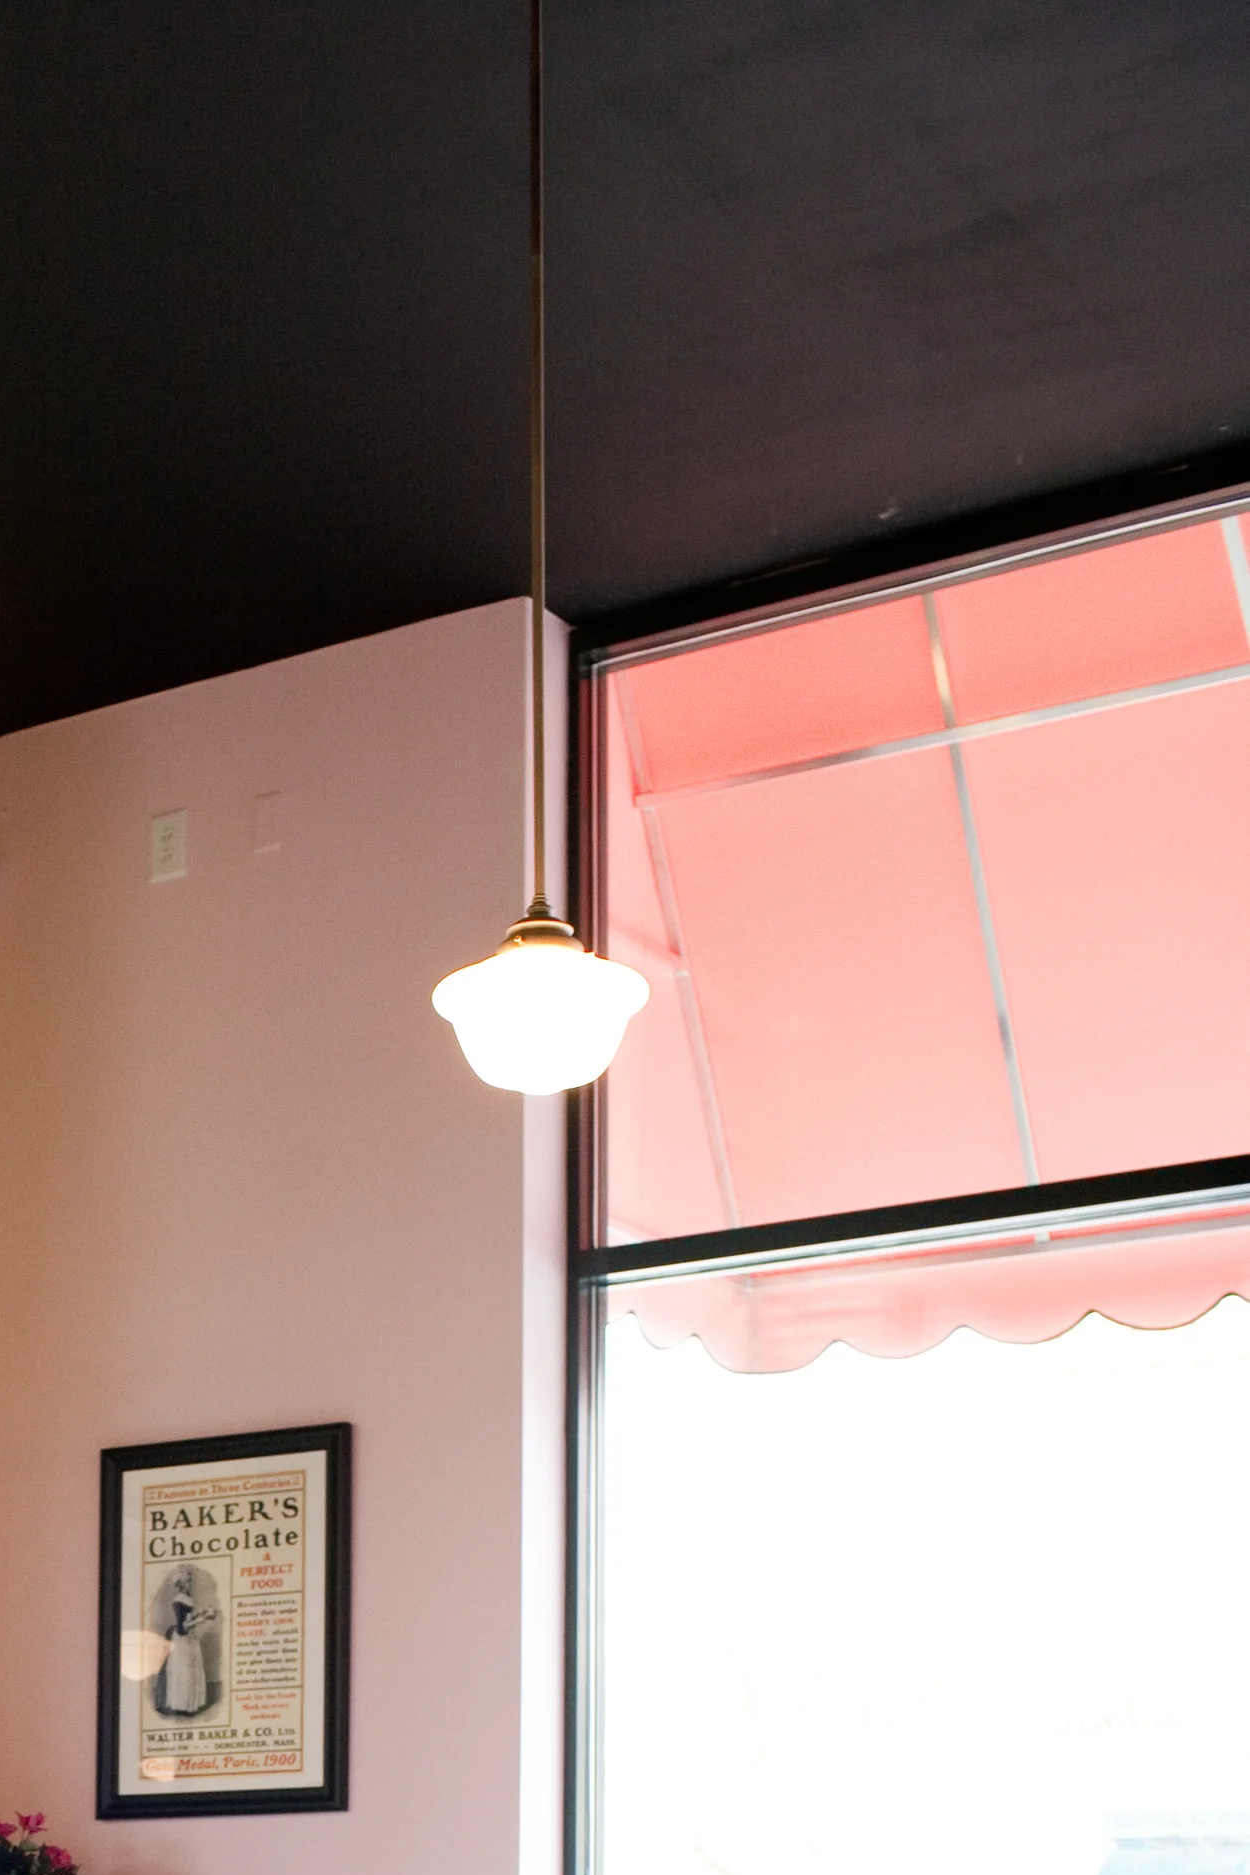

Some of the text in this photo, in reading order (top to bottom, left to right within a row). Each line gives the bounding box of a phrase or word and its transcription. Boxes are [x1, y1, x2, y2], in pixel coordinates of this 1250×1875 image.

[211, 1483, 240, 1494] Three
[150, 1497, 299, 1531] BAKER'S
[149, 1527, 299, 1558] Chocolate
[262, 1552, 271, 1561] A
[240, 1563, 293, 1577] PERFECT
[251, 1578, 283, 1590] FOOD
[147, 1731, 194, 1742] WALTER
[199, 1729, 238, 1740] BAKER
[242, 1728, 250, 1737] &
[177, 1756, 219, 1771] Medal,
[263, 1753, 297, 1767] 1900
